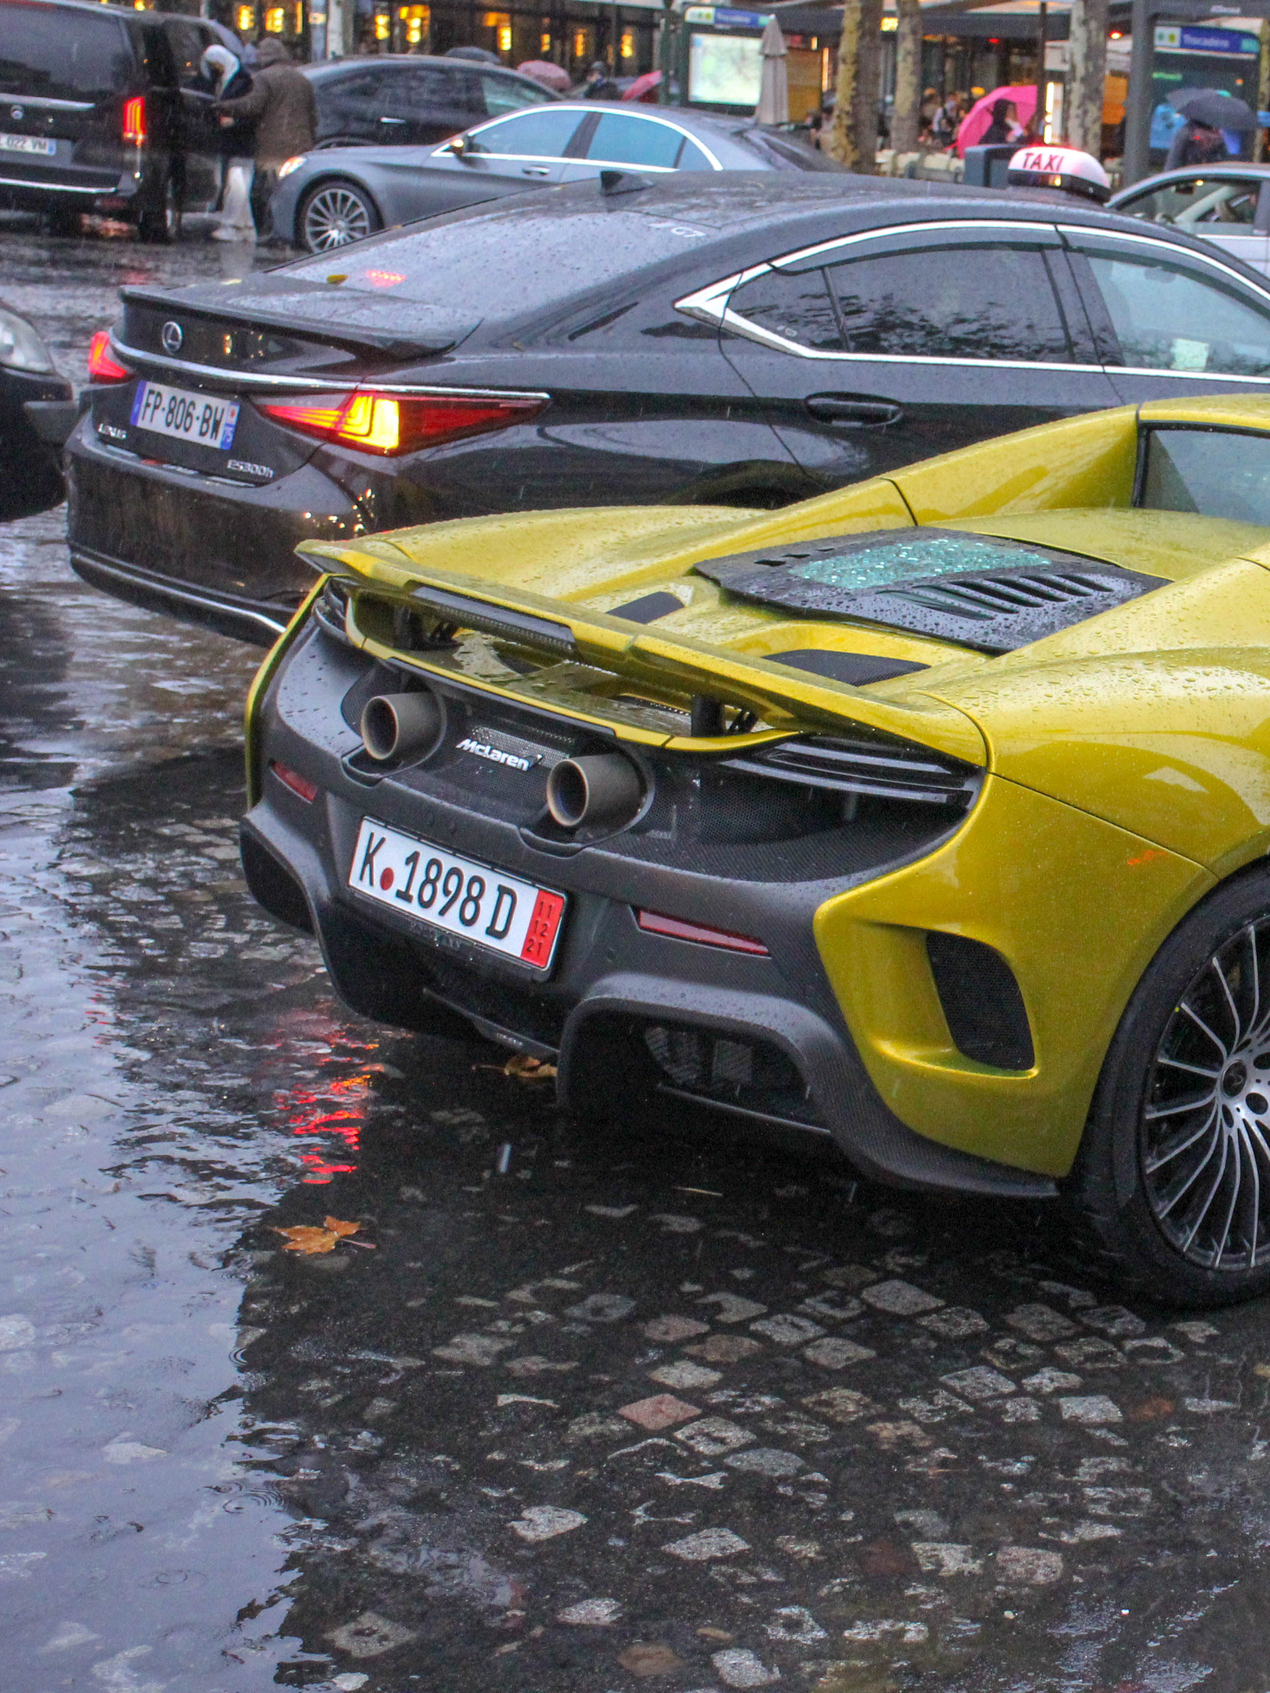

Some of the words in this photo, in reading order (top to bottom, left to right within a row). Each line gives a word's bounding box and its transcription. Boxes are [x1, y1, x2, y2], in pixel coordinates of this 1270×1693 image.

[1022, 152, 1065, 172] TAXI
[141, 389, 225, 441] FP-806-BW
[455, 737, 531, 772] McLaren
[359, 831, 386, 887] K
[395, 850, 486, 927] 1898
[485, 883, 518, 940] D
[539, 900, 554, 918] 11
[533, 919, 550, 937] 12
[525, 938, 544, 957] 21
